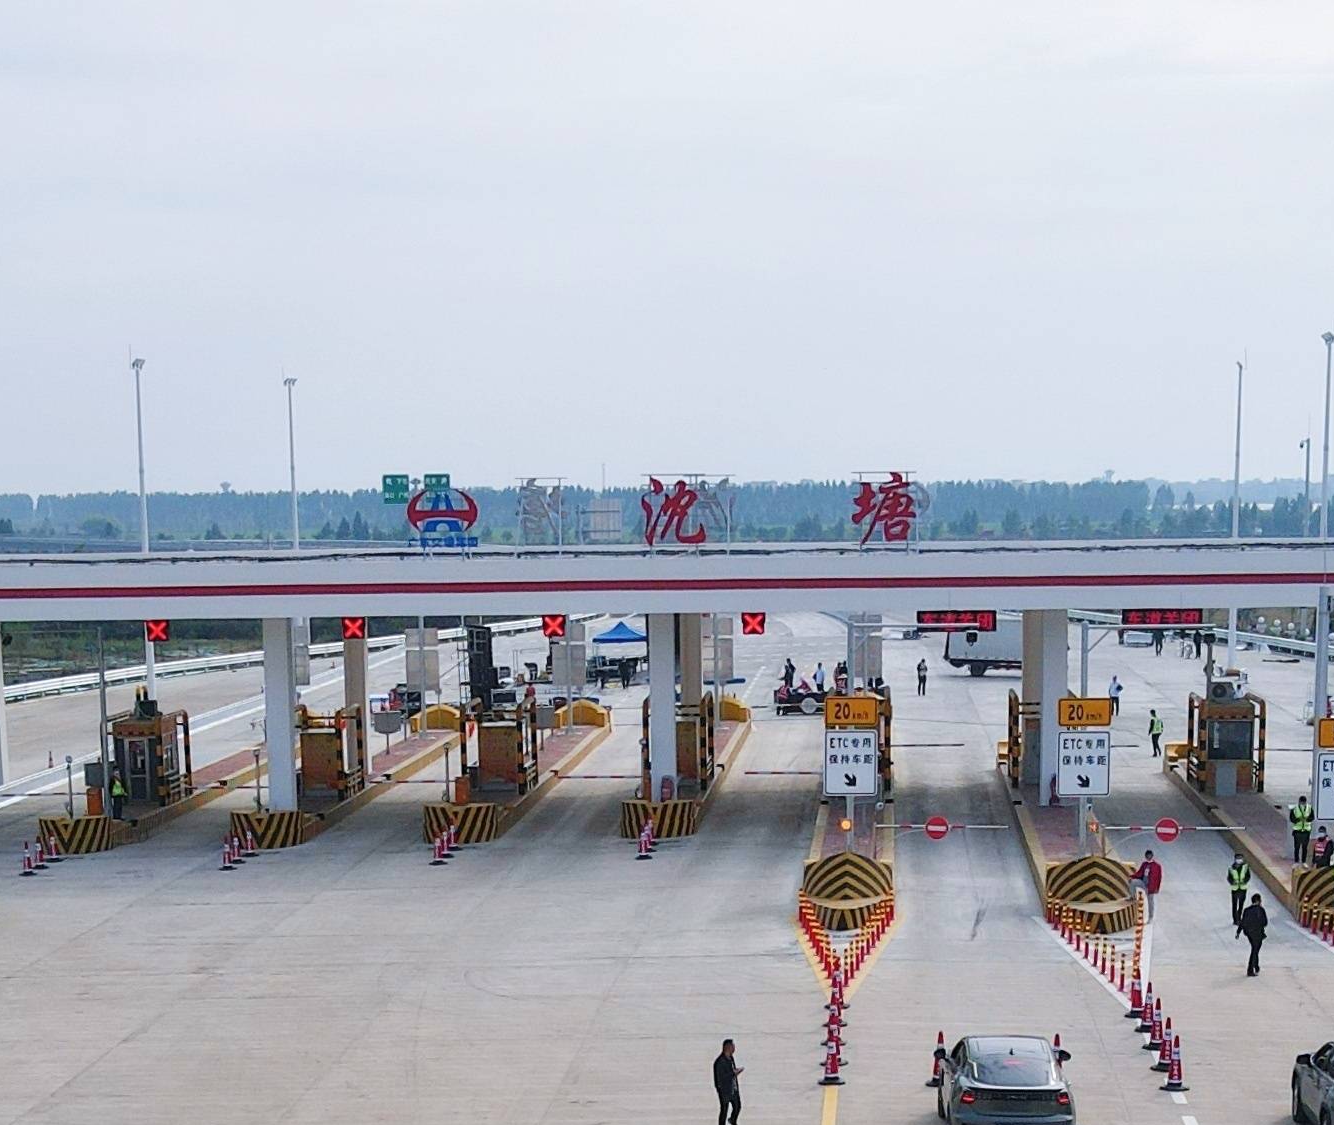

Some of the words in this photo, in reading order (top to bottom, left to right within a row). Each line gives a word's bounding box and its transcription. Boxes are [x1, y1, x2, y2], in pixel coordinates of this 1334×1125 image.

[834, 703, 850, 720] 20
[1068, 704, 1084, 721] 20
[829, 754, 874, 765] 保持车距
[1062, 755, 1107, 766] 保持车距
